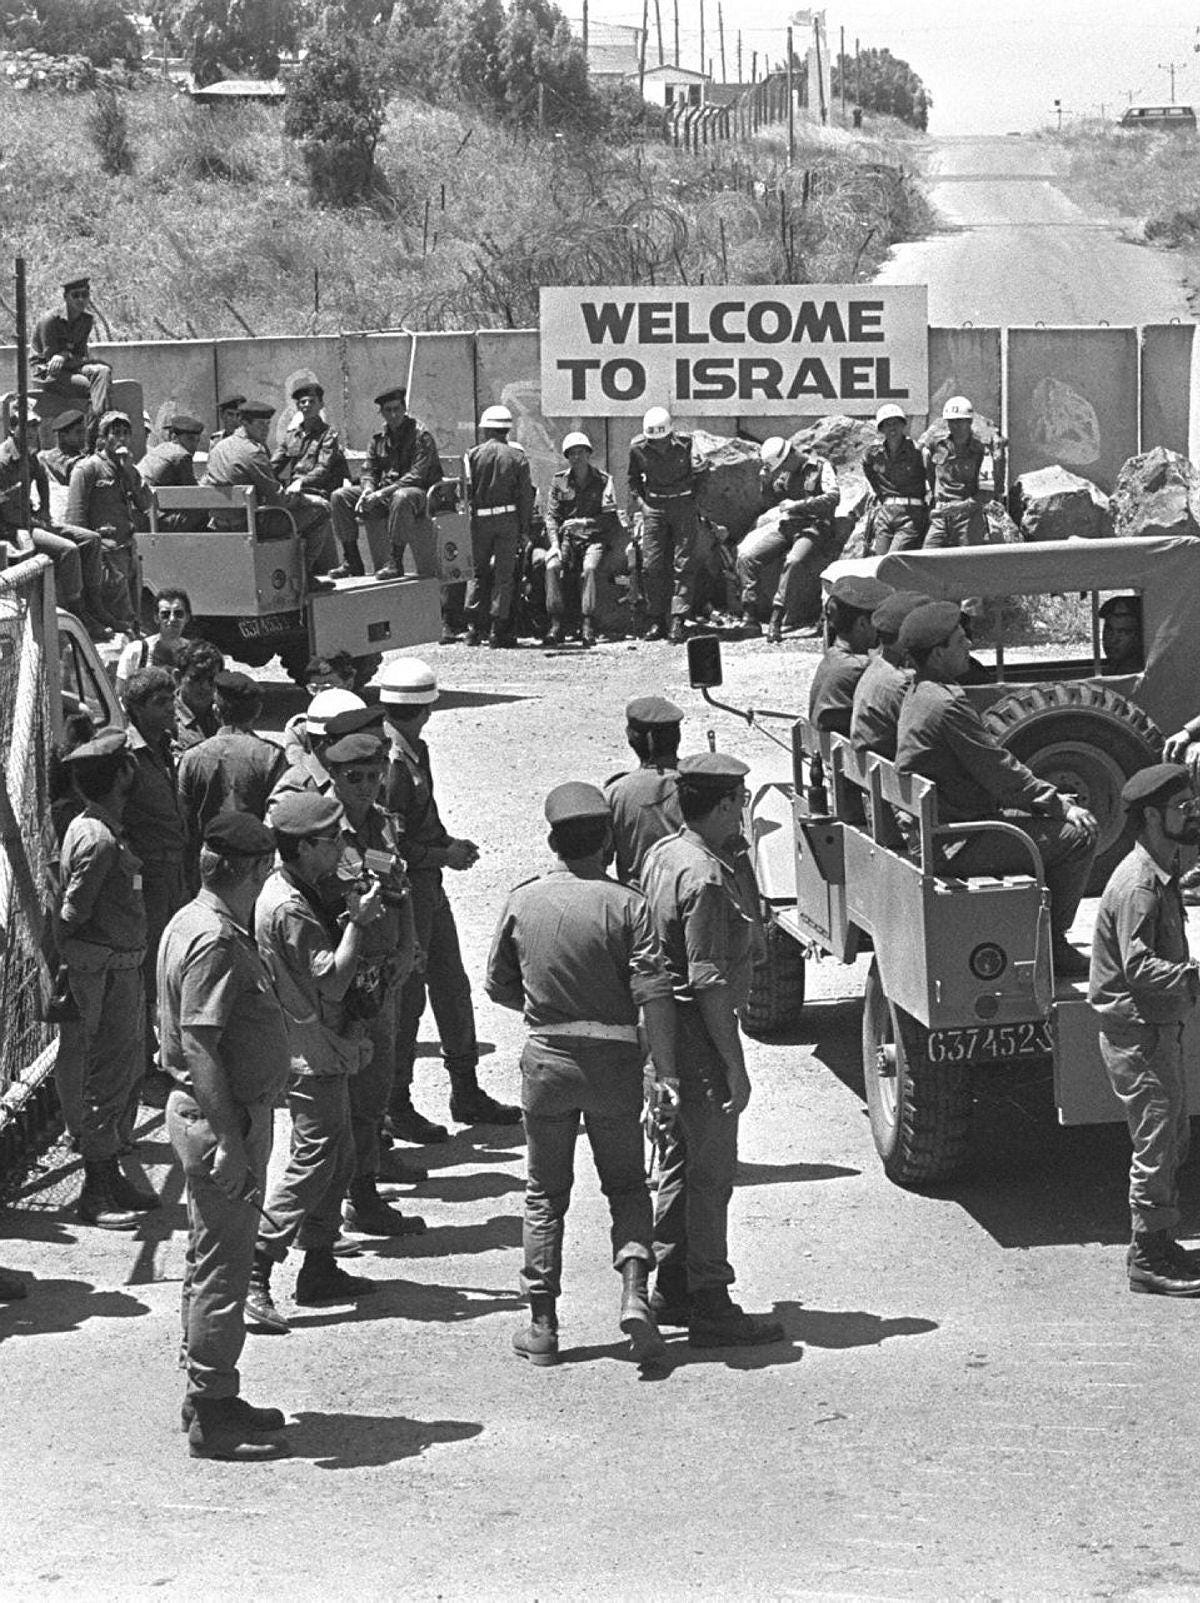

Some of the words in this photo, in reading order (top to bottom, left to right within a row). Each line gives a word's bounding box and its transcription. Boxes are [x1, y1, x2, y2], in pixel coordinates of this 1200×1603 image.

[581, 301, 885, 345] WELCOME
[556, 357, 647, 401] TO
[675, 356, 909, 400] ISRAEL
